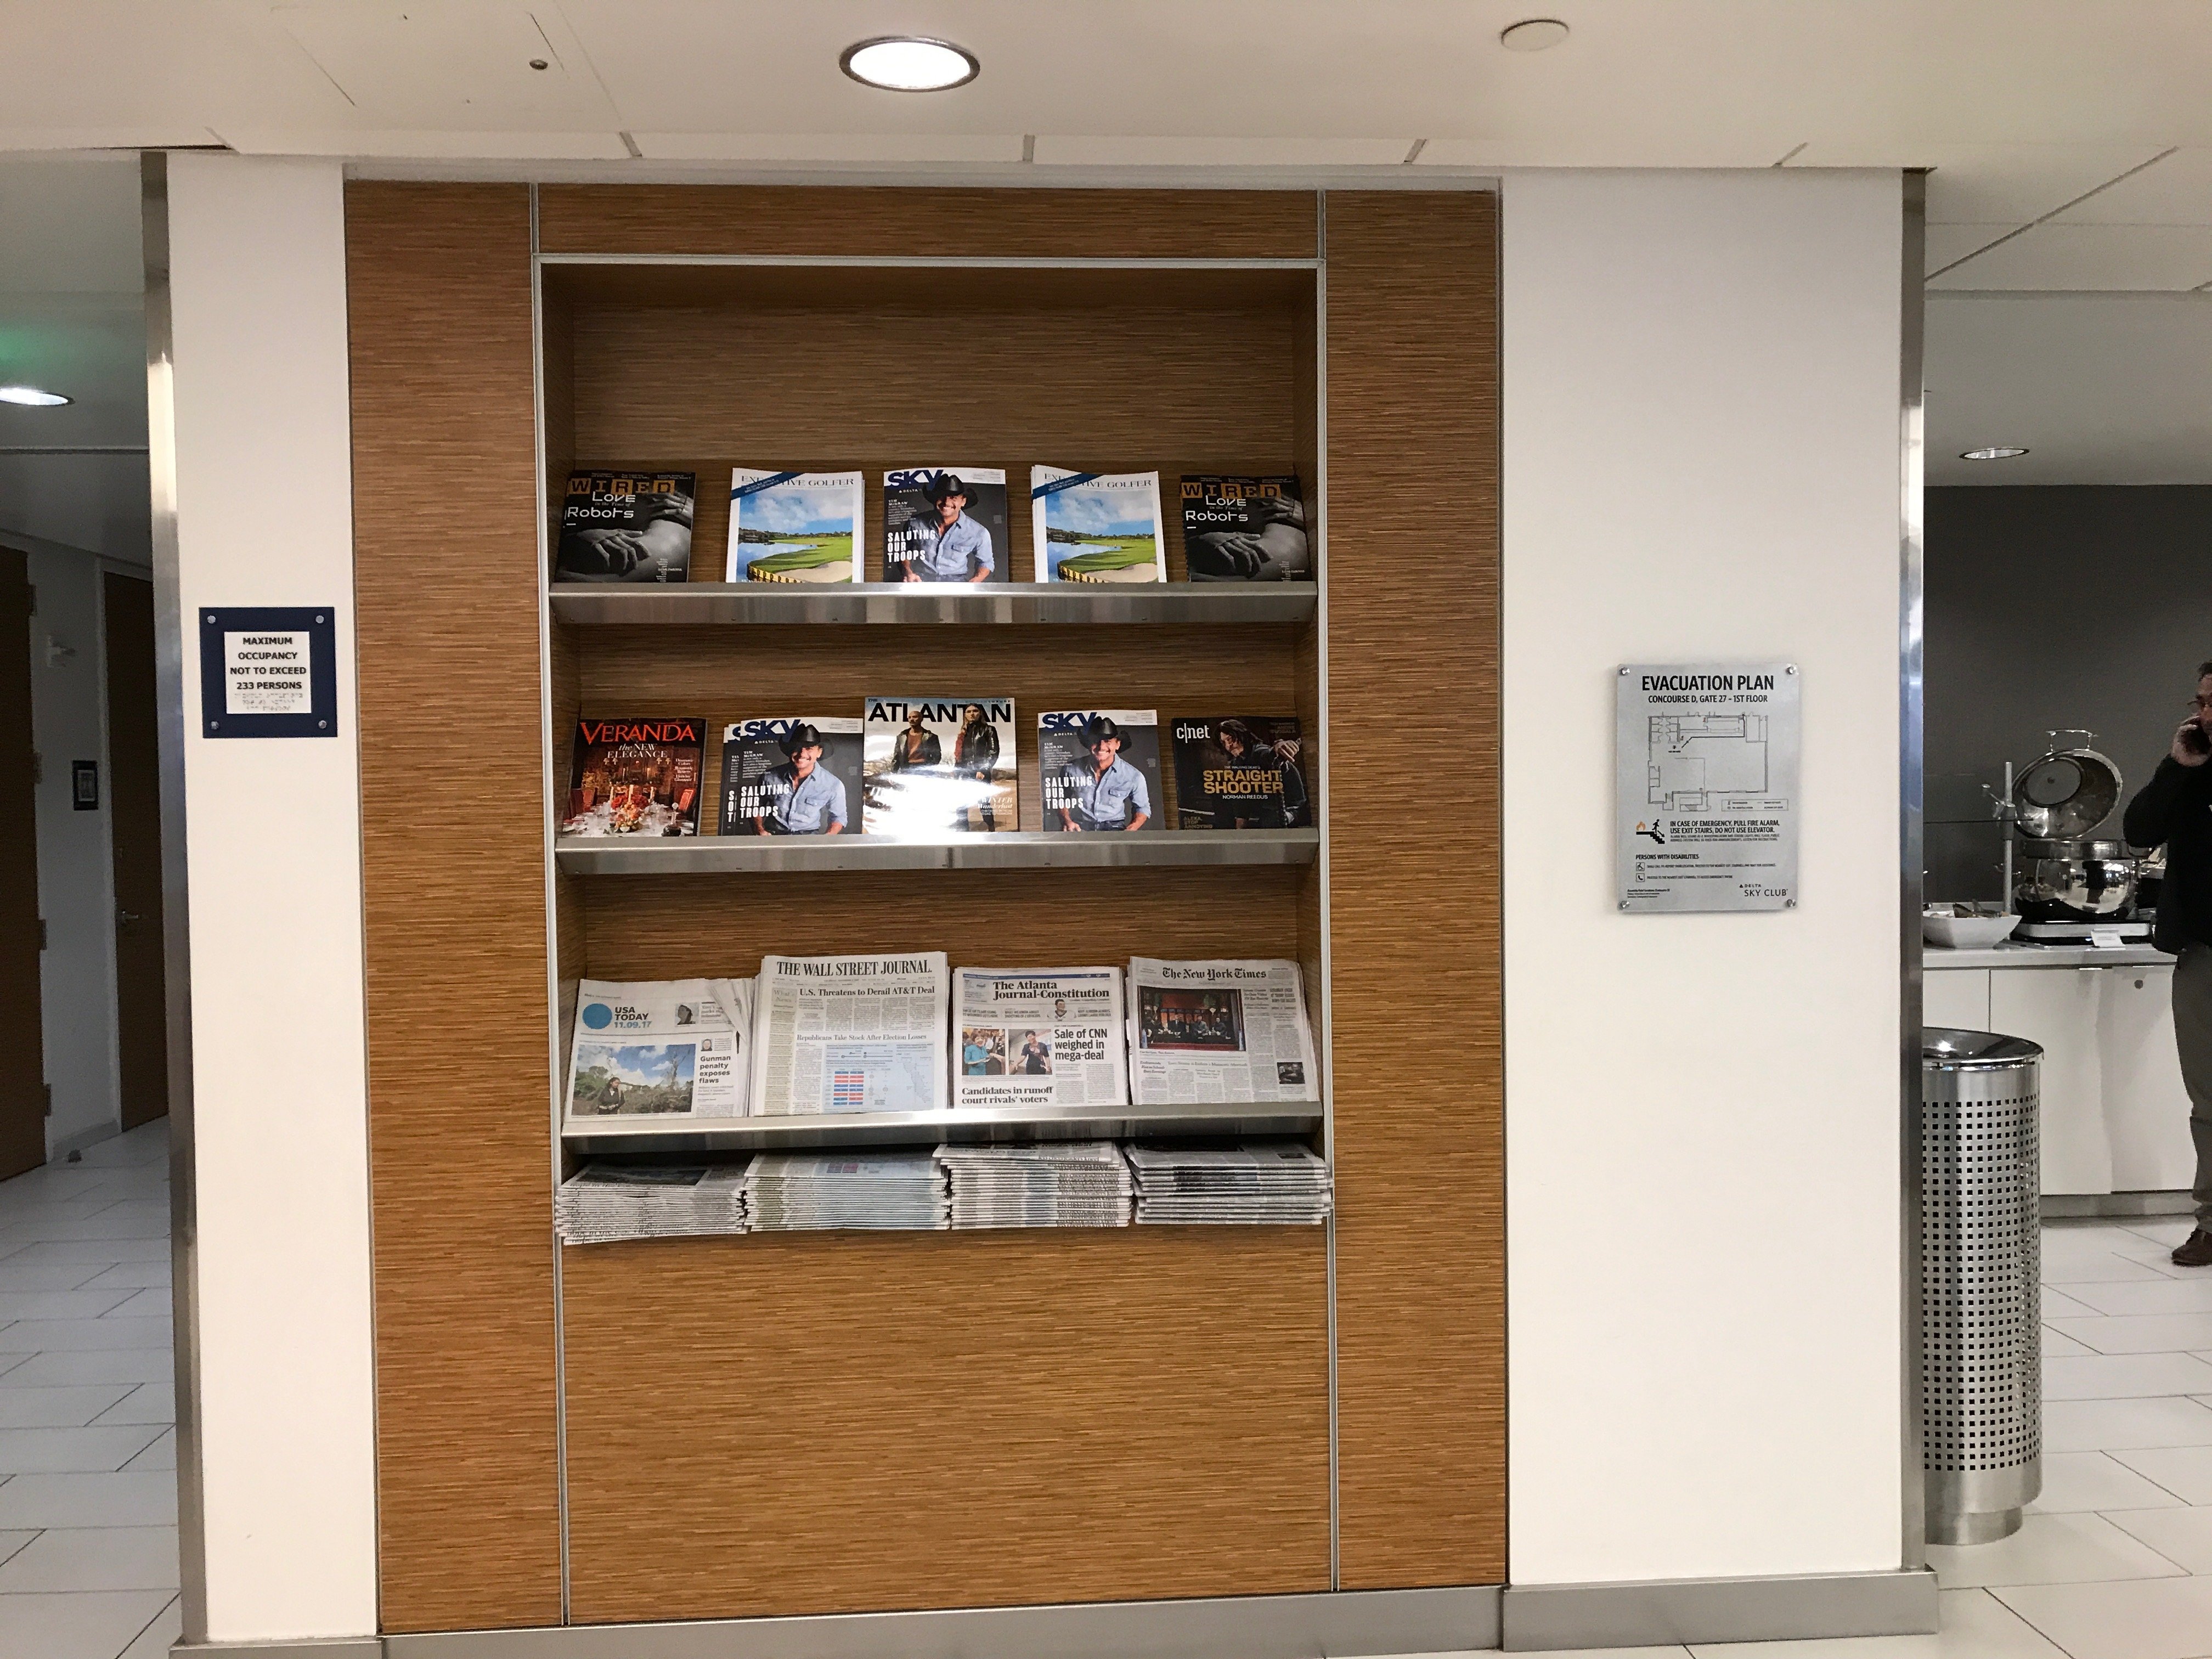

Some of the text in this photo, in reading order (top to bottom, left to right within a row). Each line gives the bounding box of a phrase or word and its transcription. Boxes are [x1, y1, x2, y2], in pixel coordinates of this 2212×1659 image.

[569, 478, 675, 494] WIRED
[741, 475, 805, 487] EXIVE
[808, 478, 854, 487] GOLFER
[888, 470, 944, 490] SKY
[1045, 473, 1103, 488] EXIVE
[1182, 482, 1282, 499] WIRED
[567, 506, 634, 518] Robots
[1186, 510, 1248, 522] Robots
[888, 529, 936, 542] SALUTING
[888, 542, 906, 552] OUR
[888, 550, 926, 563] TROOPS
[1642, 675, 1774, 691] EVACUATION PLAN
[1648, 695, 1690, 703] CONCOURSE
[1691, 695, 1698, 704] D,
[1042, 712, 1097, 733] SKY
[580, 722, 696, 745] VERANDA
[744, 719, 800, 741] SKY
[1203, 770, 1282, 781] STRAIGHT
[1045, 776, 1092, 788] SALUTING
[1204, 781, 1285, 794] SHOOTER
[741, 784, 789, 797] SALUTING
[1046, 788, 1064, 798] OUR
[741, 796, 759, 807] OUR
[1046, 798, 1084, 810] TROOPS
[740, 805, 778, 819] TROOPS
[777, 960, 933, 977] THE WALL STREET JOURNAL.
[1163, 967, 1266, 981] The New York Times
[993, 980, 1057, 990] The Atlanta
[799, 988, 816, 996] U.S.
[818, 988, 856, 996] Threatens
[867, 987, 890, 996] Derail
[992, 988, 1109, 1001] Journal-Constitution
[1054, 1028, 1107, 1039] Sale of CNN
[1054, 1040, 1104, 1051] weighed in
[1055, 1050, 1104, 1062] mega-deal
[1024, 1086, 1053, 1094] runoff
